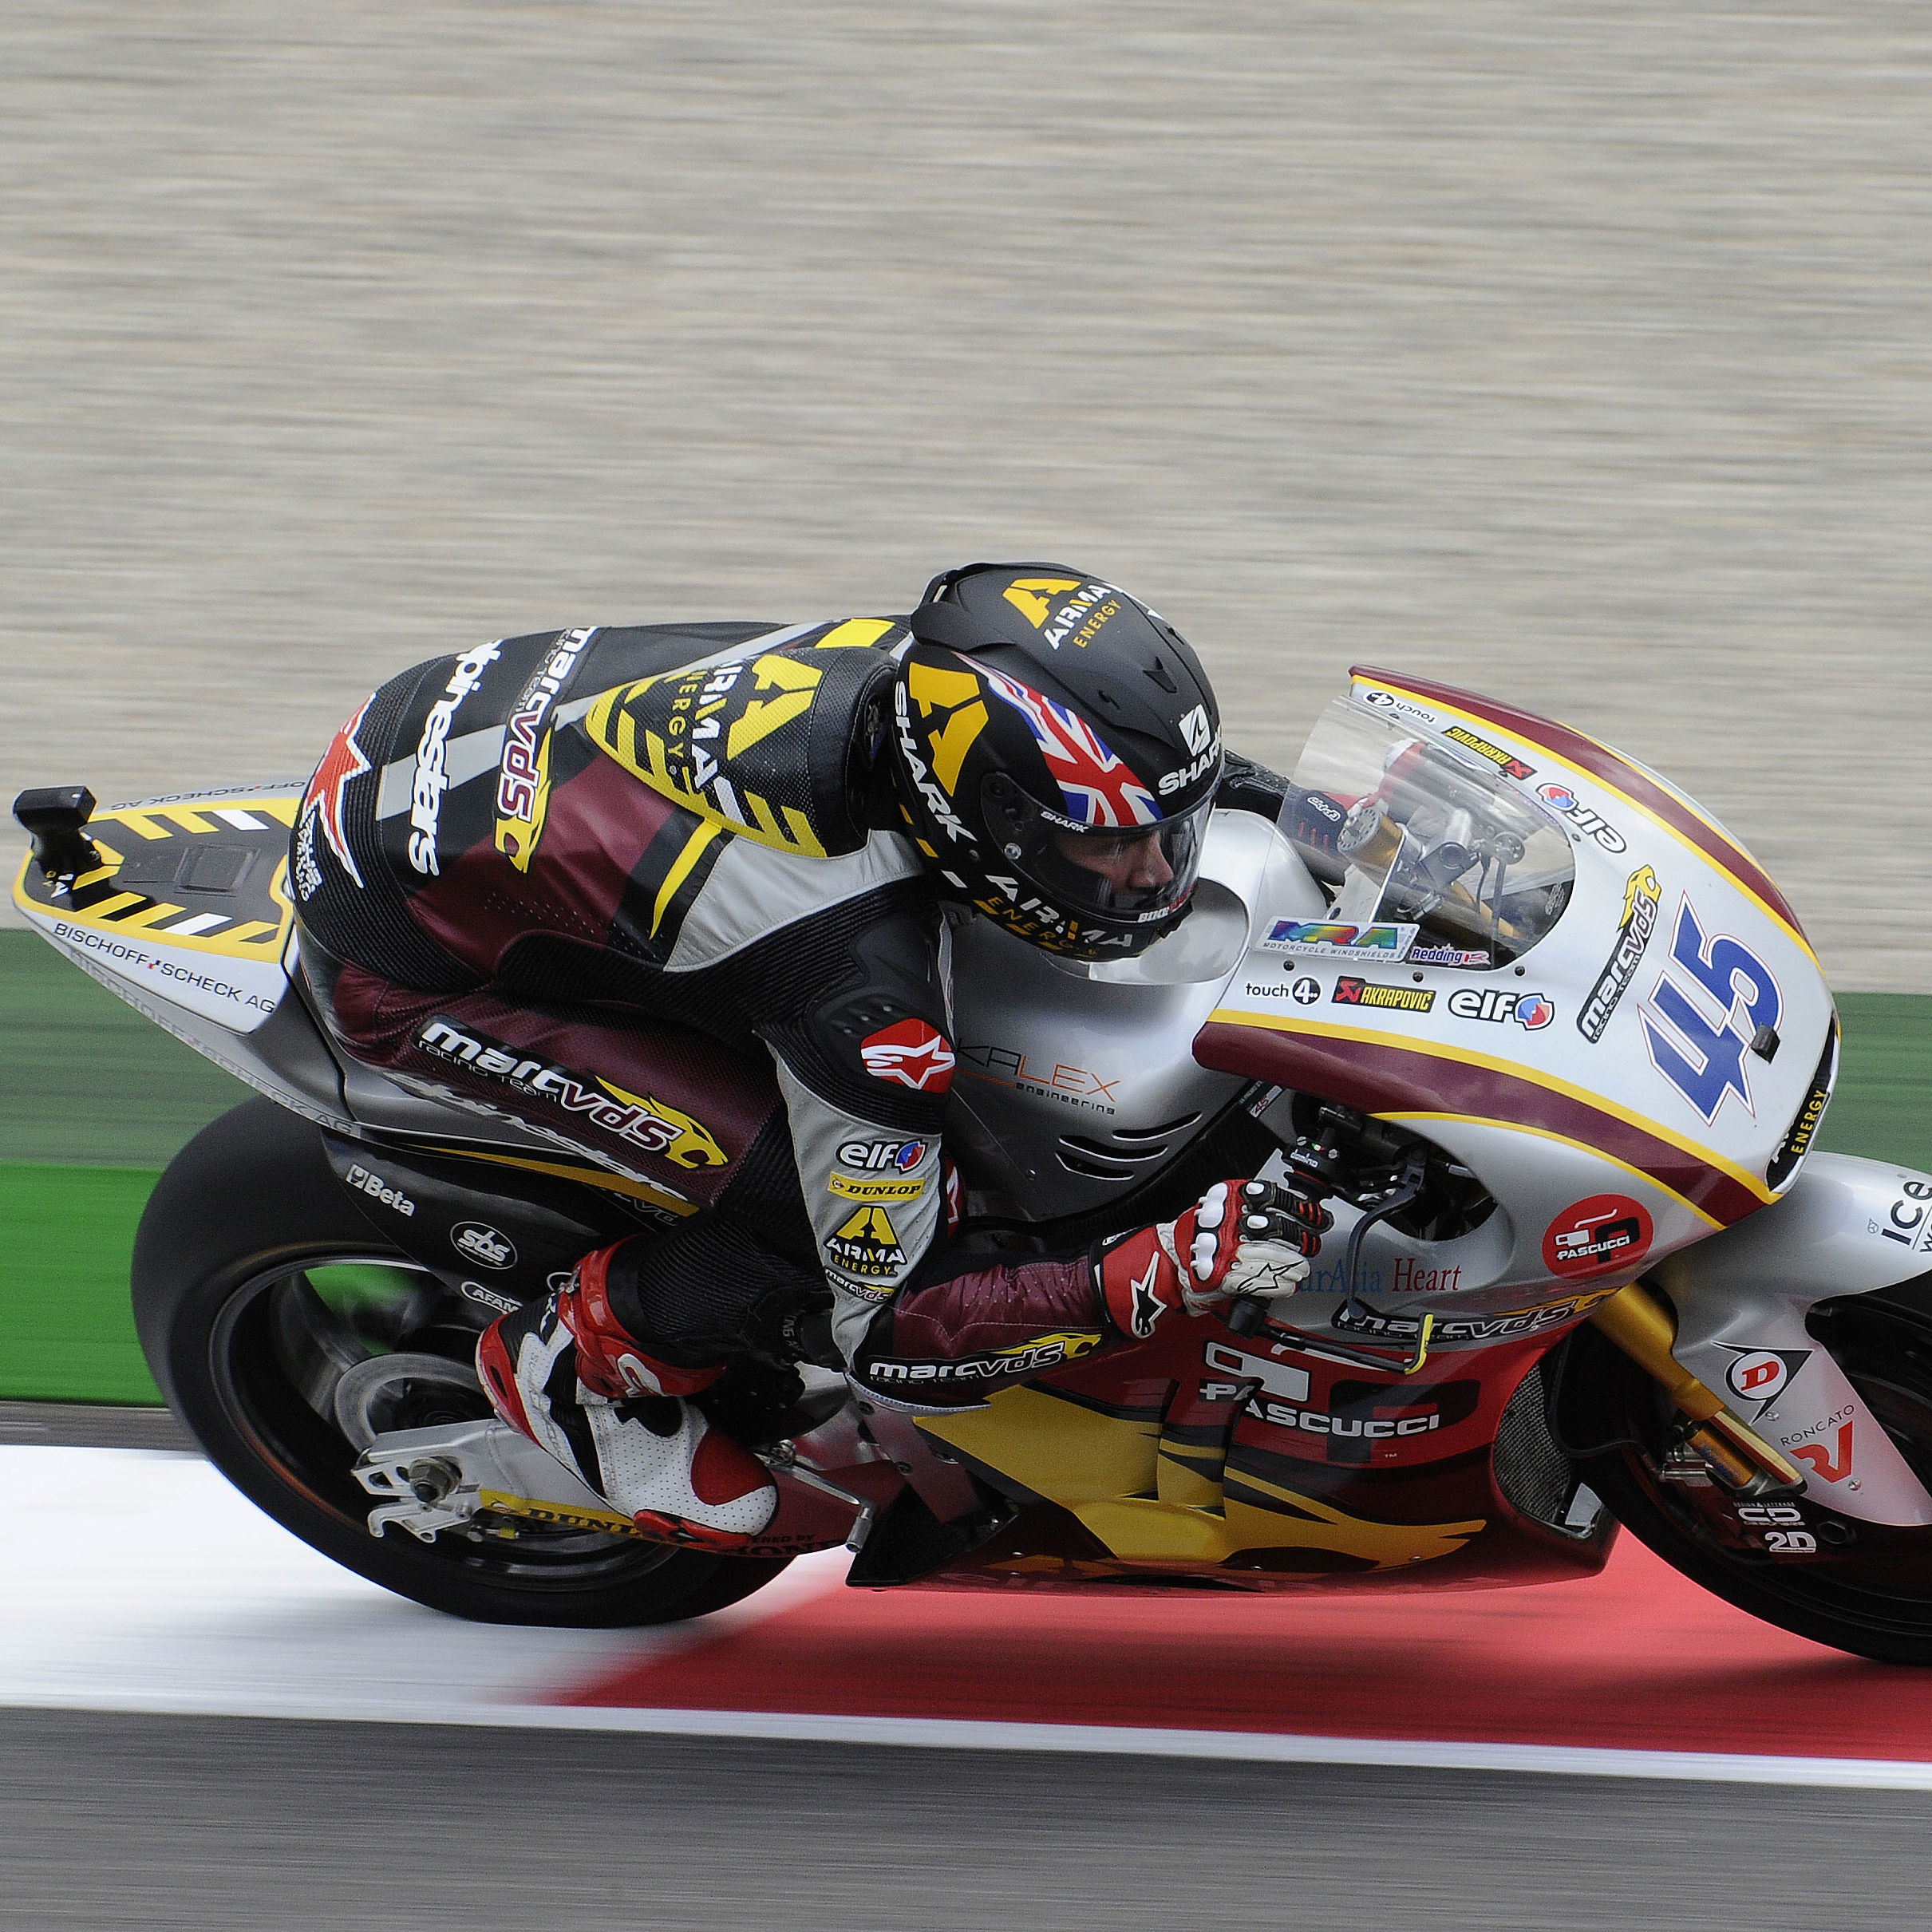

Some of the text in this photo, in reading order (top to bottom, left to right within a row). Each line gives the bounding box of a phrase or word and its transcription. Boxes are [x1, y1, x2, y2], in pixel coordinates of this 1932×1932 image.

[1042, 582, 1112, 650] ARMA
[1073, 599, 1122, 649] ENERGY
[1395, 701, 1436, 722] touch
[895, 681, 978, 844] SHARK
[1040, 810, 1090, 834] SHARK
[1567, 801, 1627, 853] elf
[1262, 941, 1326, 954] MOTORCYCLE
[1267, 920, 1398, 950] MRA
[53, 922, 150, 966] BISCHOFF
[160, 961, 243, 1002] SCHECK
[246, 994, 275, 1014] AG
[1411, 944, 1463, 966] Redding
[1582, 889, 1659, 1038] marcvds
[1246, 982, 1289, 999] touch
[1450, 990, 1518, 1021] elf
[1638, 889, 1785, 1128] 45
[421, 1021, 685, 1152] marcvds
[956, 1037, 1121, 1103] KALEX
[1016, 1082, 1116, 1116] engineering
[1790, 1088, 1827, 1155] ENERGY
[839, 1142, 899, 1170] elf
[362, 1180, 416, 1217] Beta
[846, 1184, 922, 1196] DUNLOP
[826, 1237, 907, 1266] ARMA
[833, 1254, 891, 1276] ENERGY
[1556, 1236, 1630, 1261] PASCUCCI
[824, 1267, 894, 1302] marcvds
[1392, 1258, 1462, 1292] Heart
[472, 1289, 520, 1313] AFAM
[869, 1341, 1066, 1380] marcvds
[1199, 1381, 1440, 1439] PASCUCCI
[1780, 1404, 1856, 1448] RONCATO
[1764, 1531, 1817, 1554] 2D
